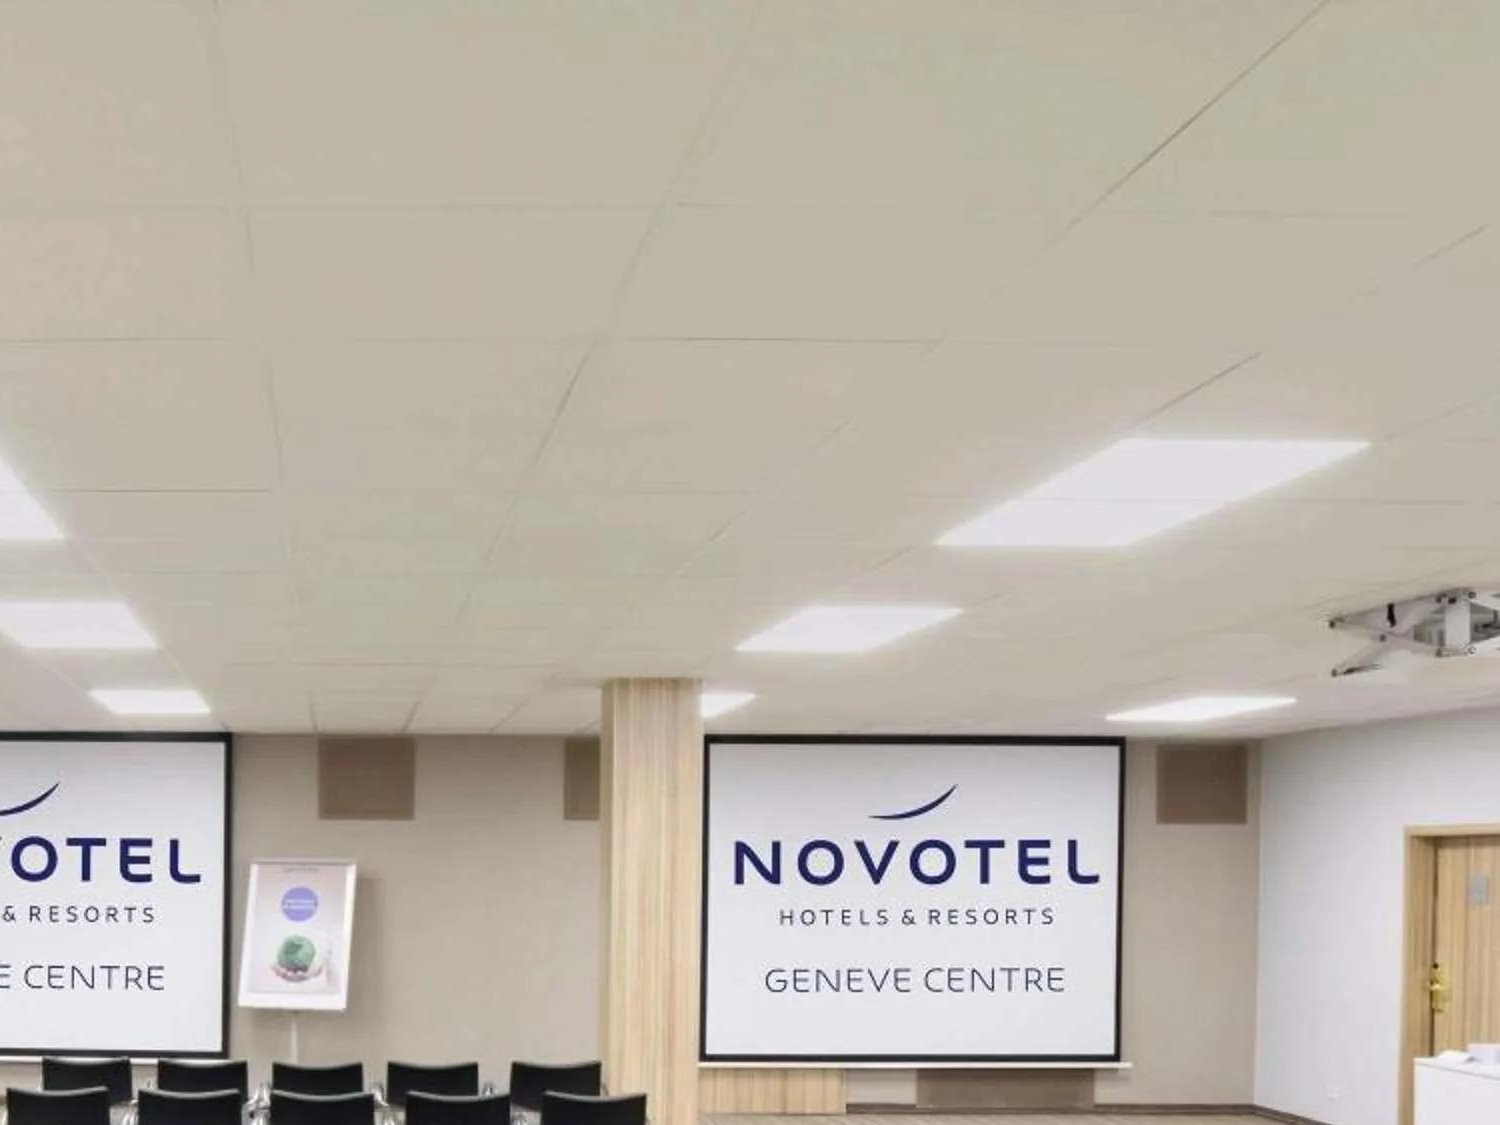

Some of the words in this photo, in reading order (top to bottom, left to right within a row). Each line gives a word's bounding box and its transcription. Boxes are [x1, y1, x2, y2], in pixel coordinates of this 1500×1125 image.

[734, 839, 1101, 887] NOVOTEL
[2, 904, 17, 922] &
[29, 905, 156, 923] RESORTS
[779, 908, 889, 926] HOTELS
[901, 908, 917, 926] &
[928, 908, 1055, 926] RESORTS
[23, 964, 165, 991] CENTRE
[764, 967, 912, 993] GENEVE
[923, 967, 1066, 993] CENTRE
